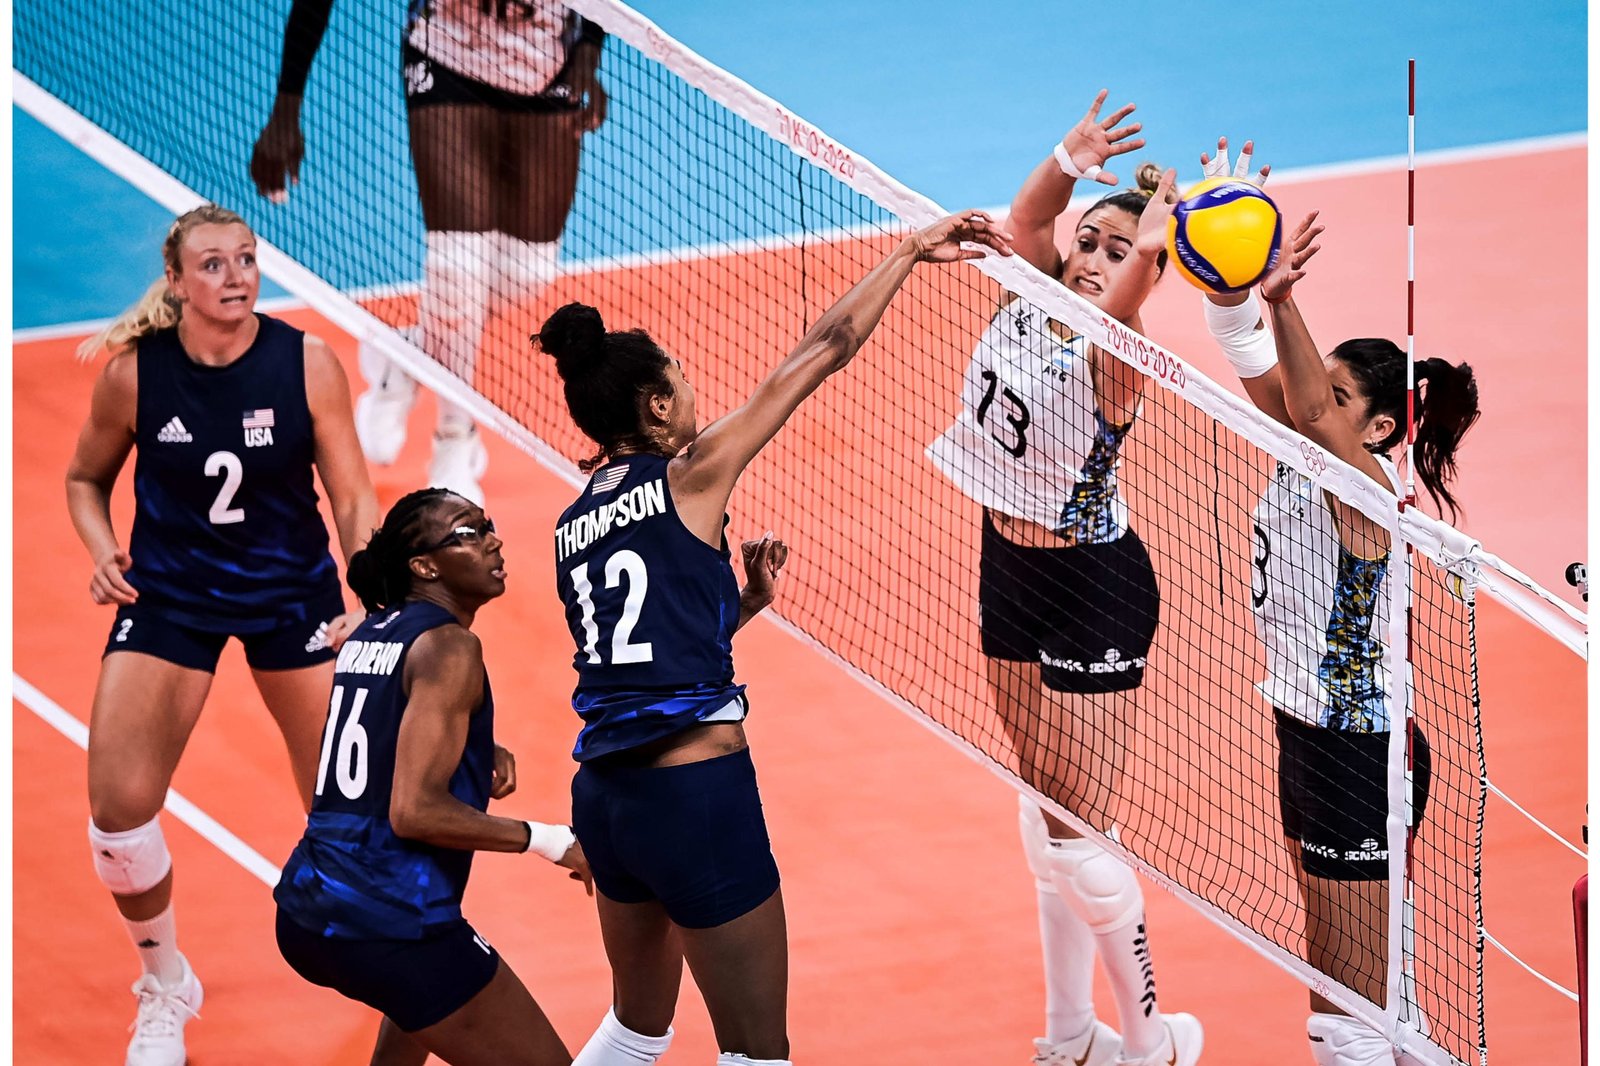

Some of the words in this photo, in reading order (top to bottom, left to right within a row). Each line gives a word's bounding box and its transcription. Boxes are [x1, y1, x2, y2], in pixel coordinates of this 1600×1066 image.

[1043, 365, 1067, 384] ARG
[1102, 316, 1149, 367] TOKYO
[1149, 346, 1186, 389] 2020
[244, 427, 274, 448] USA
[977, 370, 1031, 459] 13
[204, 450, 245, 525] 2
[555, 478, 667, 563] THOMPSON
[115, 618, 133, 642] 2
[569, 549, 654, 665] 12
[315, 685, 370, 800] 16
